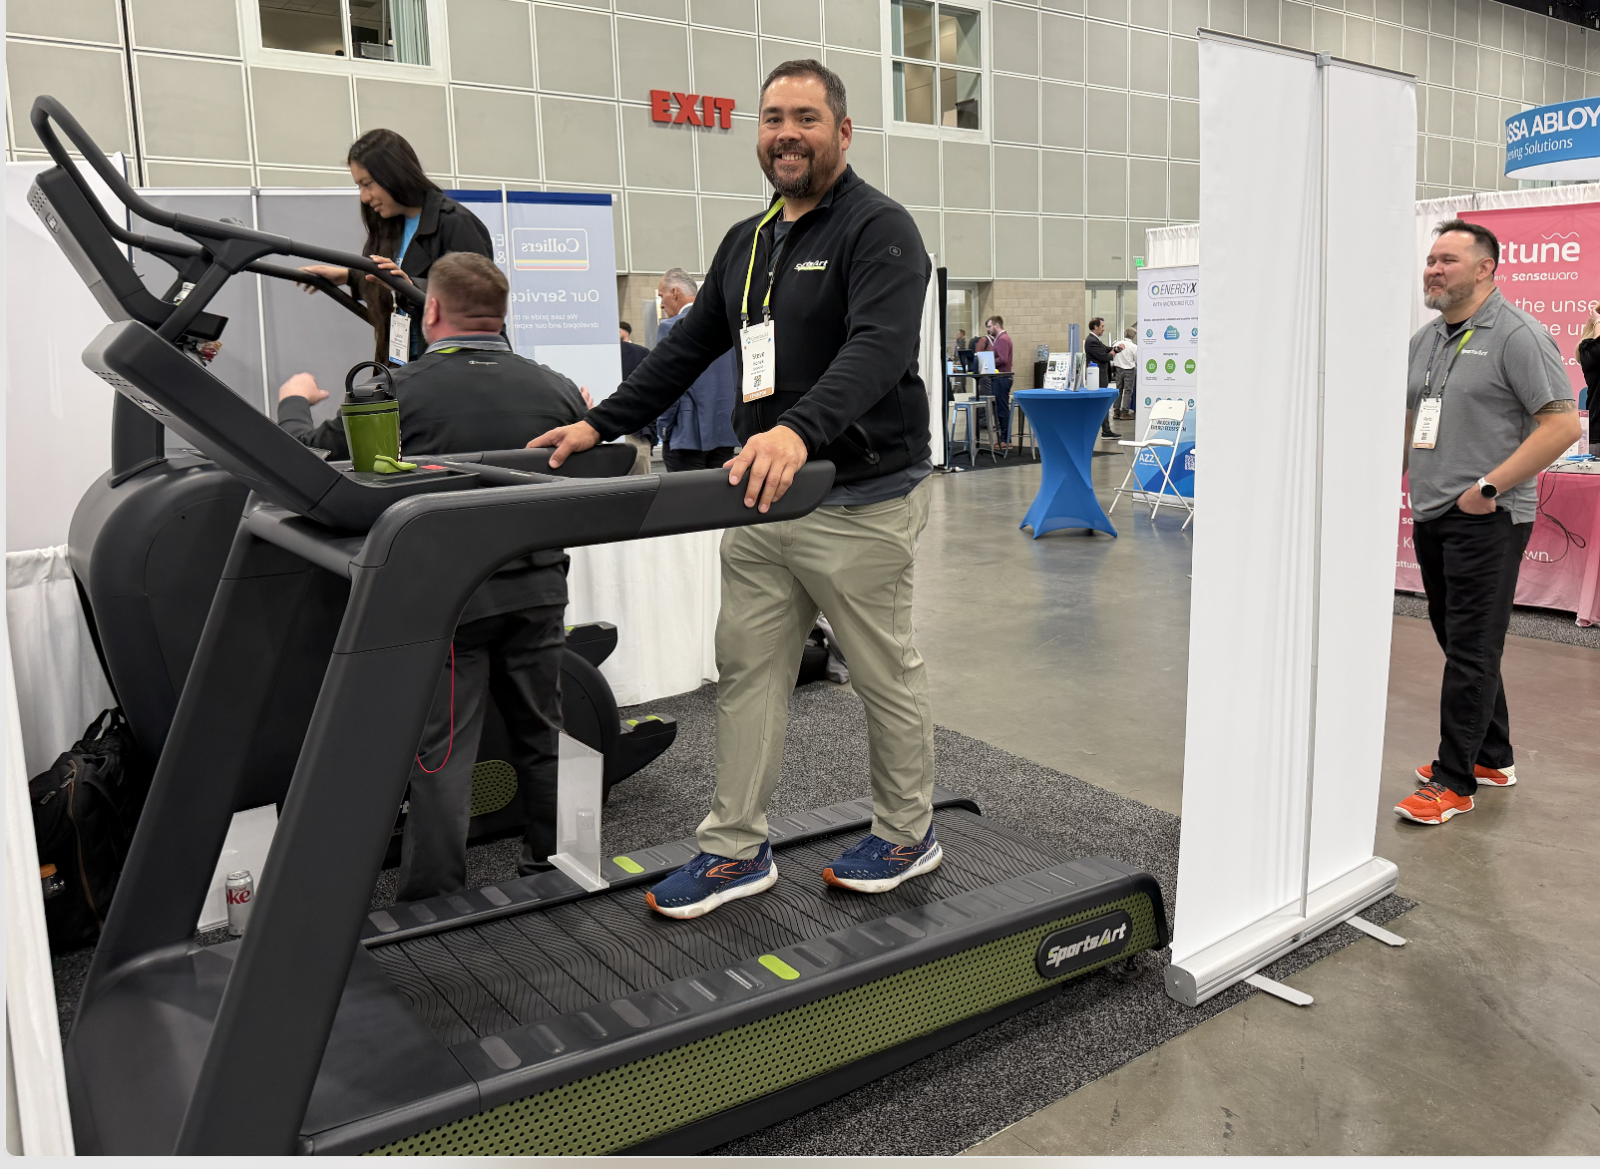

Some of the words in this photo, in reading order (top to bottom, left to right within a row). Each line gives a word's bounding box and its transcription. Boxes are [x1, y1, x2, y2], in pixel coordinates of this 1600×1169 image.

[650, 89, 735, 129] EXIT
[1507, 119, 1529, 144] SSA
[1531, 105, 1600, 137] ABLOY
[1507, 146, 1523, 161] ening
[1524, 138, 1573, 156] Solutions
[1498, 241, 1580, 264] ttune
[1494, 273, 1507, 282] erly
[1512, 271, 1579, 281] senseware
[1160, 282, 1197, 295] ENERGYX
[1515, 297, 1545, 313] the
[1552, 299, 1598, 313] unse
[1139, 453, 1155, 463] AZZ
[226, 889, 251, 905] ke
[1046, 922, 1127, 968] SportsArt
